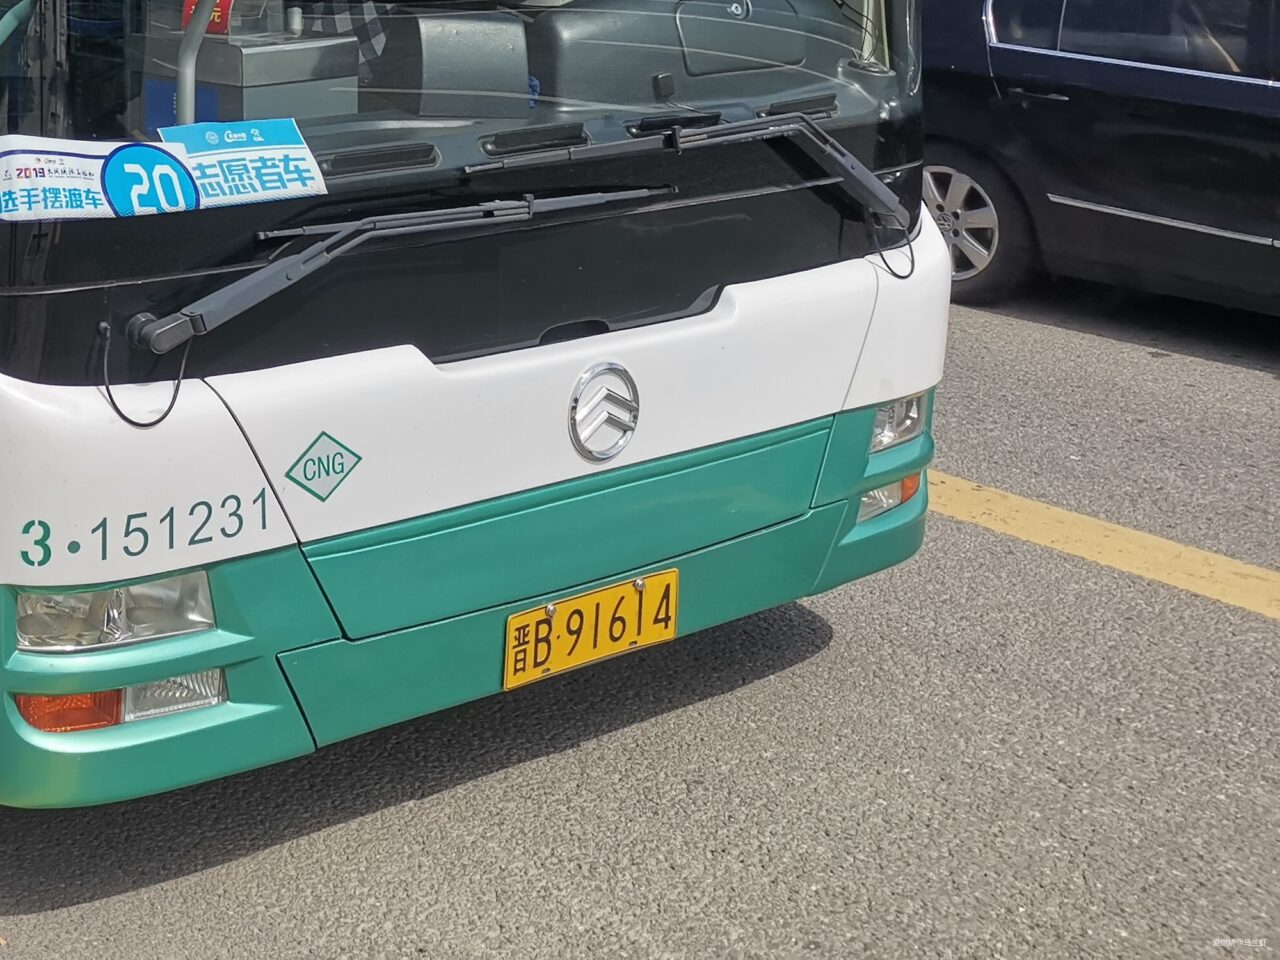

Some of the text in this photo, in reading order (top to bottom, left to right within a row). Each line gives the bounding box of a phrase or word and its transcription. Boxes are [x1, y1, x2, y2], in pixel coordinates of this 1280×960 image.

[16, 167, 46, 179] 2019
[124, 161, 187, 213] 20
[195, 155, 317, 200] 志愿者车
[302, 451, 346, 482] CNG
